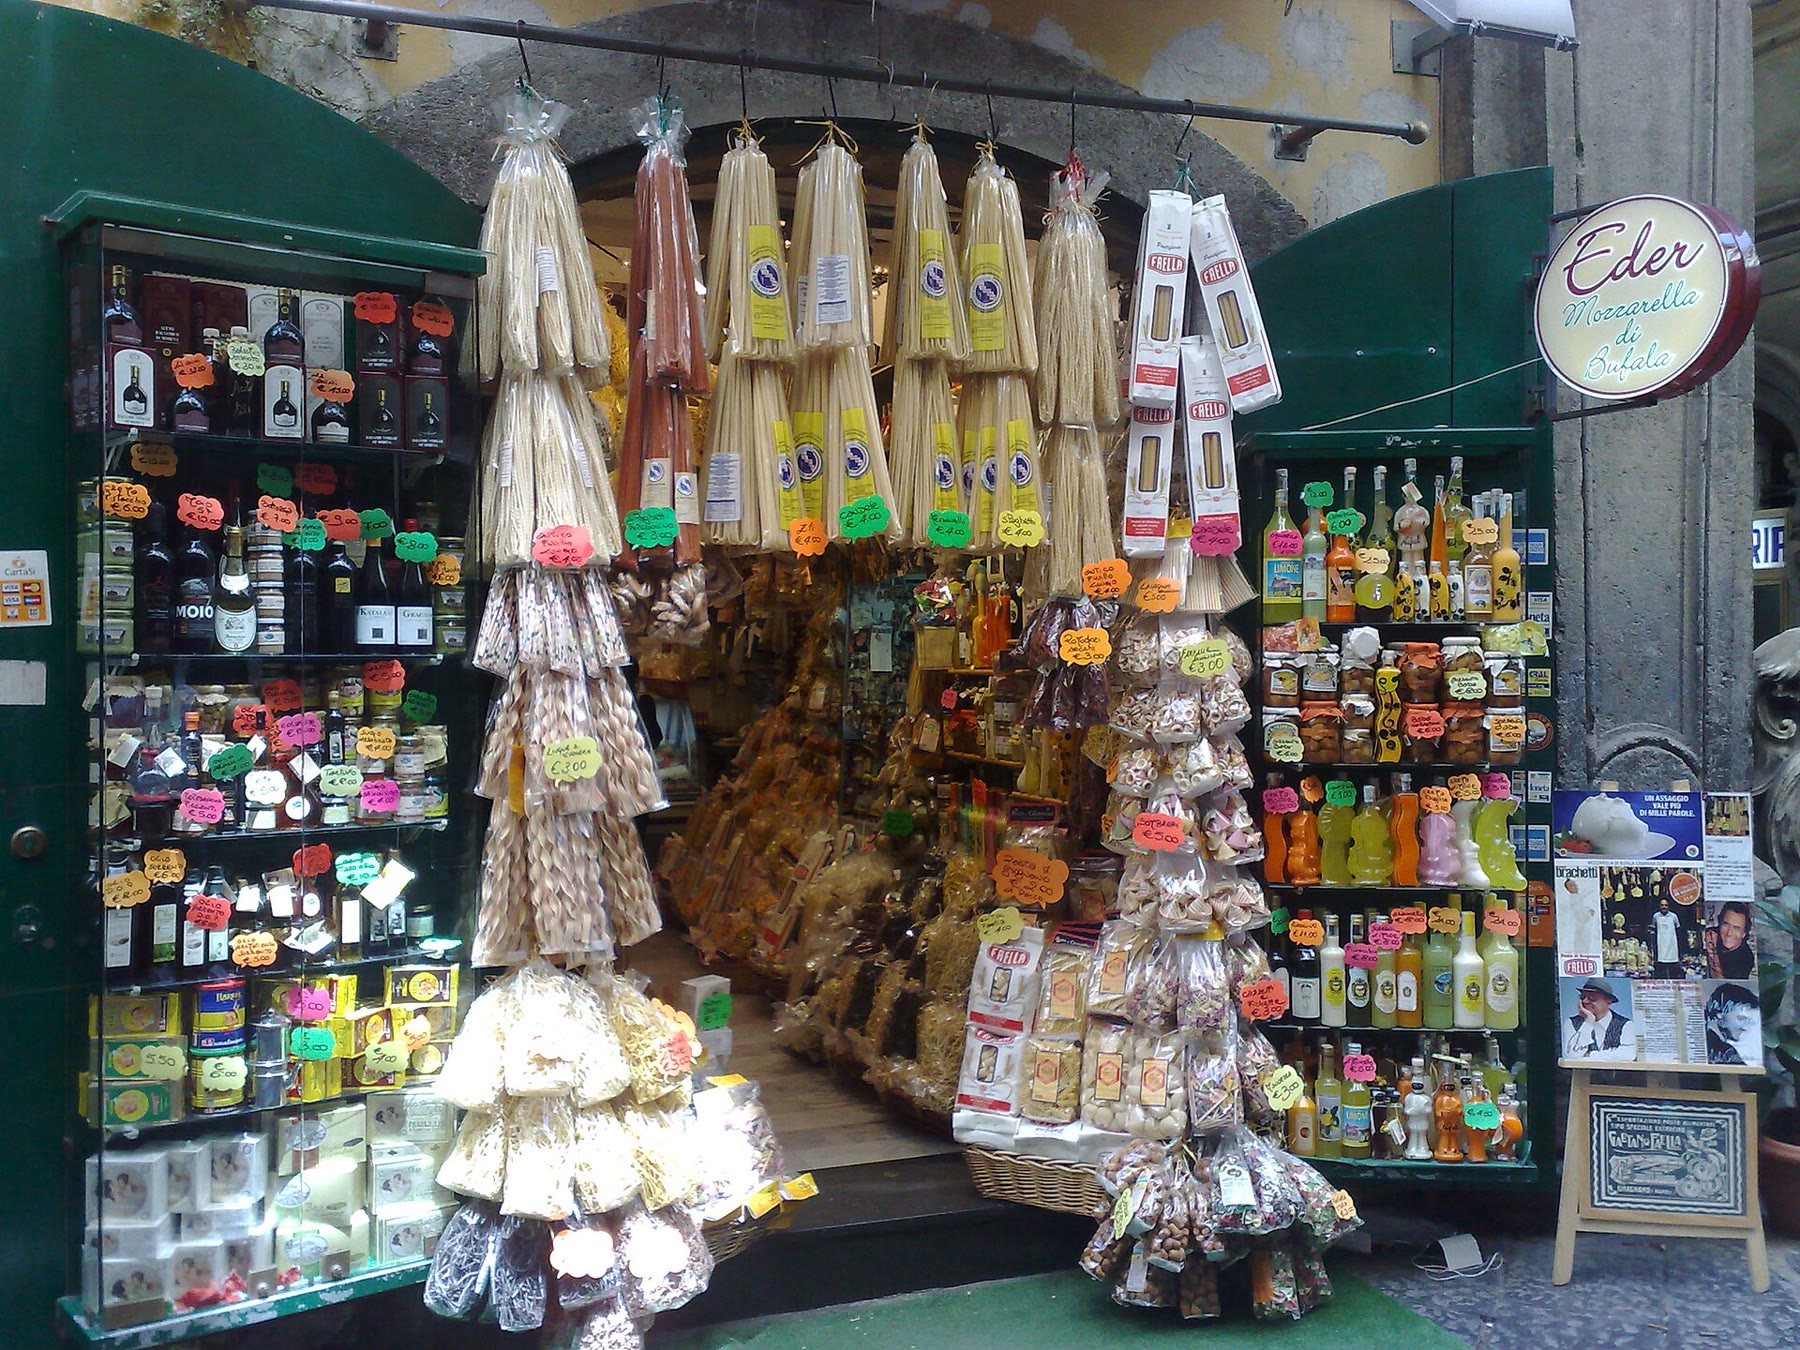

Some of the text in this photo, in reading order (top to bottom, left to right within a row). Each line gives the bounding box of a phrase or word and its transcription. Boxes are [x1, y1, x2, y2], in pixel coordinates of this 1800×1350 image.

[1151, 254, 1184, 272] FAELLA
[1563, 220, 1704, 296] Eder
[1203, 259, 1236, 283] FAELLA
[1563, 281, 1701, 327] Mozzarella
[1616, 319, 1642, 345] di
[1584, 343, 1674, 381] Bufala
[1192, 402, 1227, 417] FAELLA
[1655, 795, 1690, 803] ASSAGGIO
[1556, 866, 1598, 878] brachetti
[990, 947, 1027, 965] FAELLA
[1566, 960, 1594, 973] FAELLA
